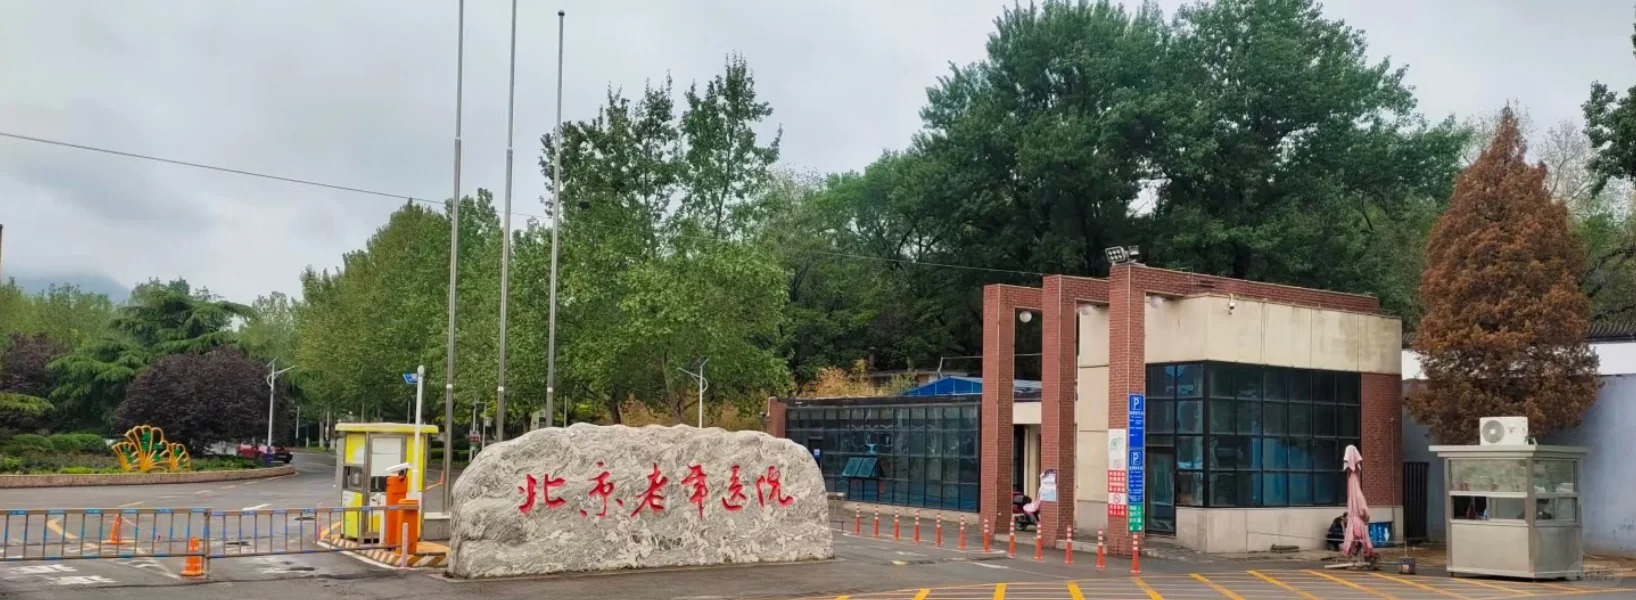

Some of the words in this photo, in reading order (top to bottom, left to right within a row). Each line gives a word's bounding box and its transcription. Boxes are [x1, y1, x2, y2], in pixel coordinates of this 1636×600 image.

[517, 461, 794, 519] 北京老年医院
